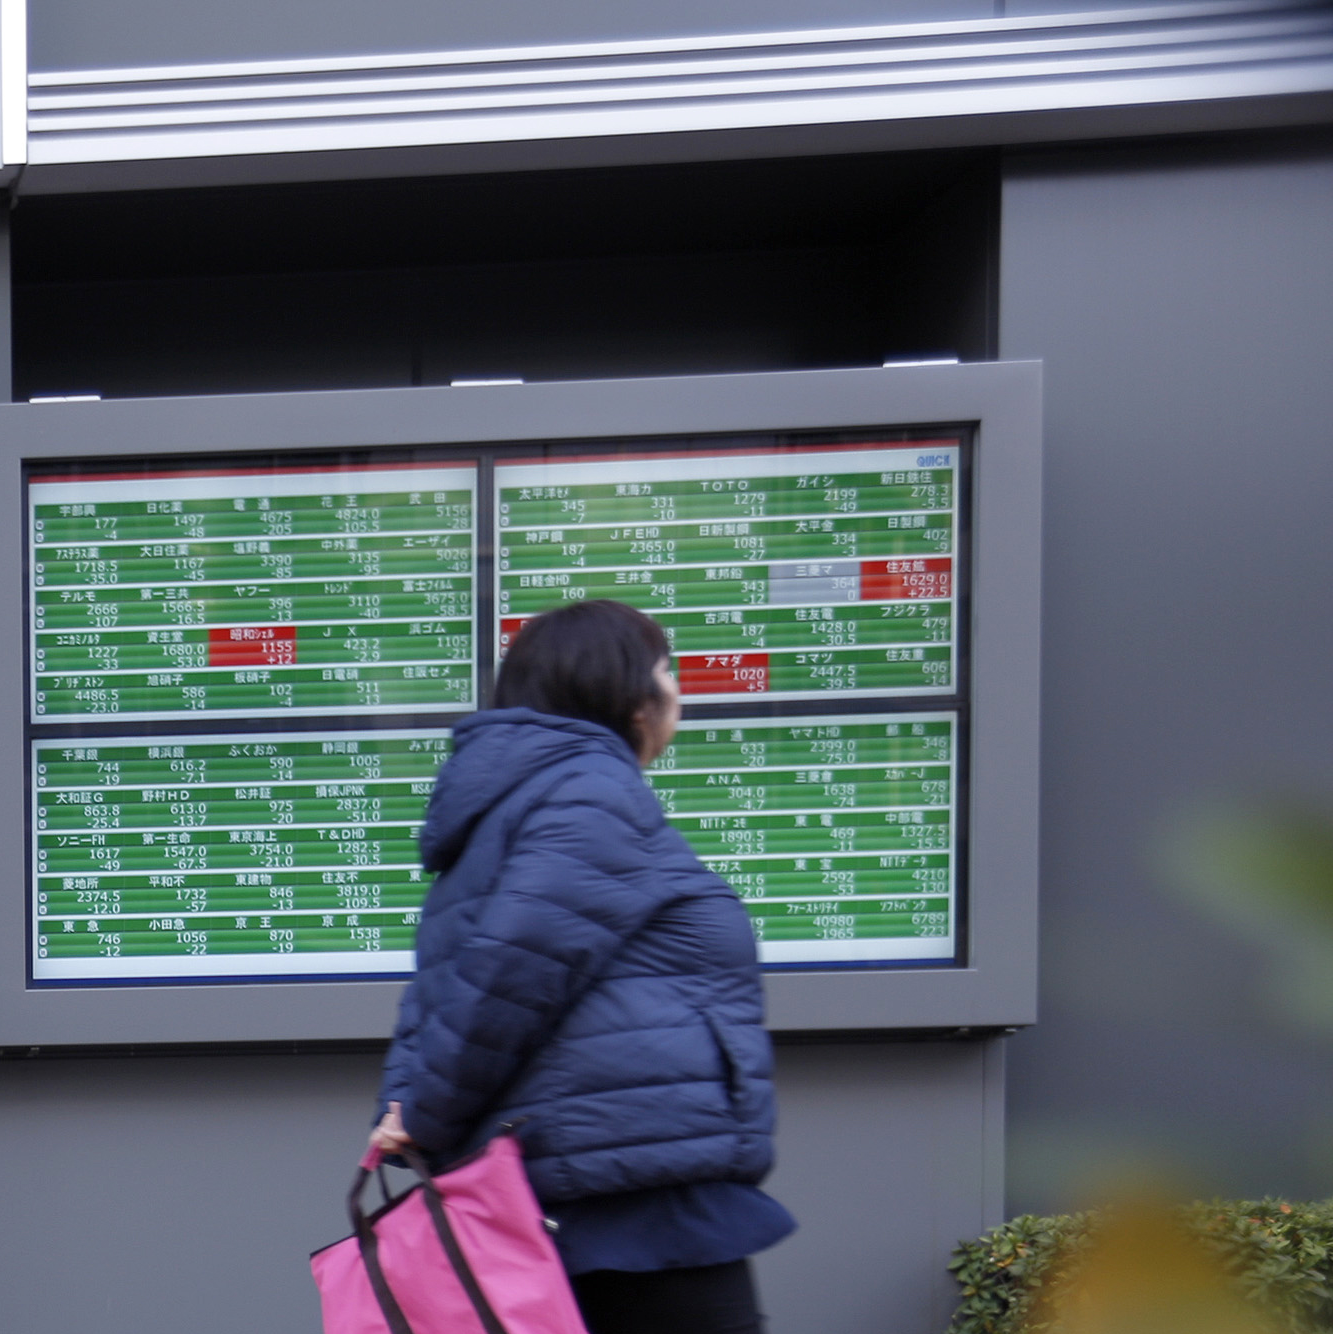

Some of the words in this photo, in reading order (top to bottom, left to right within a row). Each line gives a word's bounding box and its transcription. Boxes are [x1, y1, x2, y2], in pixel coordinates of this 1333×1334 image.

[796, 476, 833, 487] ガイシ
[734, 492, 765, 504] 1279
[824, 488, 856, 501] 2199
[901, 573, 946, 586] 1629.0
[60, 591, 95, 602] テルモ
[234, 586, 269, 596] ヤフー
[86, 602, 117, 614] 2666
[268, 597, 291, 609] 396
[261, 640, 292, 652] 1155
[267, 653, 291, 664] +12
[705, 655, 741, 667] アマダ
[796, 653, 831, 663] コマツ
[733, 667, 764, 680] 1020
[810, 664, 855, 677] 2447.5
[75, 689, 118, 700] 4486.5
[182, 686, 205, 698] 586
[706, 774, 740, 784] ANA
[727, 786, 764, 798] 304.0
[84, 804, 119, 816] 863.8
[170, 802, 206, 814] 613.0
[142, 832, 190, 844] 第一生命
[720, 830, 764, 842] 1890.5
[164, 845, 206, 857] 1547.0
[250, 843, 292, 855] 3754.0
[149, 875, 184, 886] 平和不
[176, 888, 206, 899] 1732
[336, 884, 379, 896] 3819.0
[814, 914, 854, 927] 40980
[913, 911, 946, 924] 6789
[149, 918, 184, 930] 小田急
[177, 931, 206, 942] 1056
